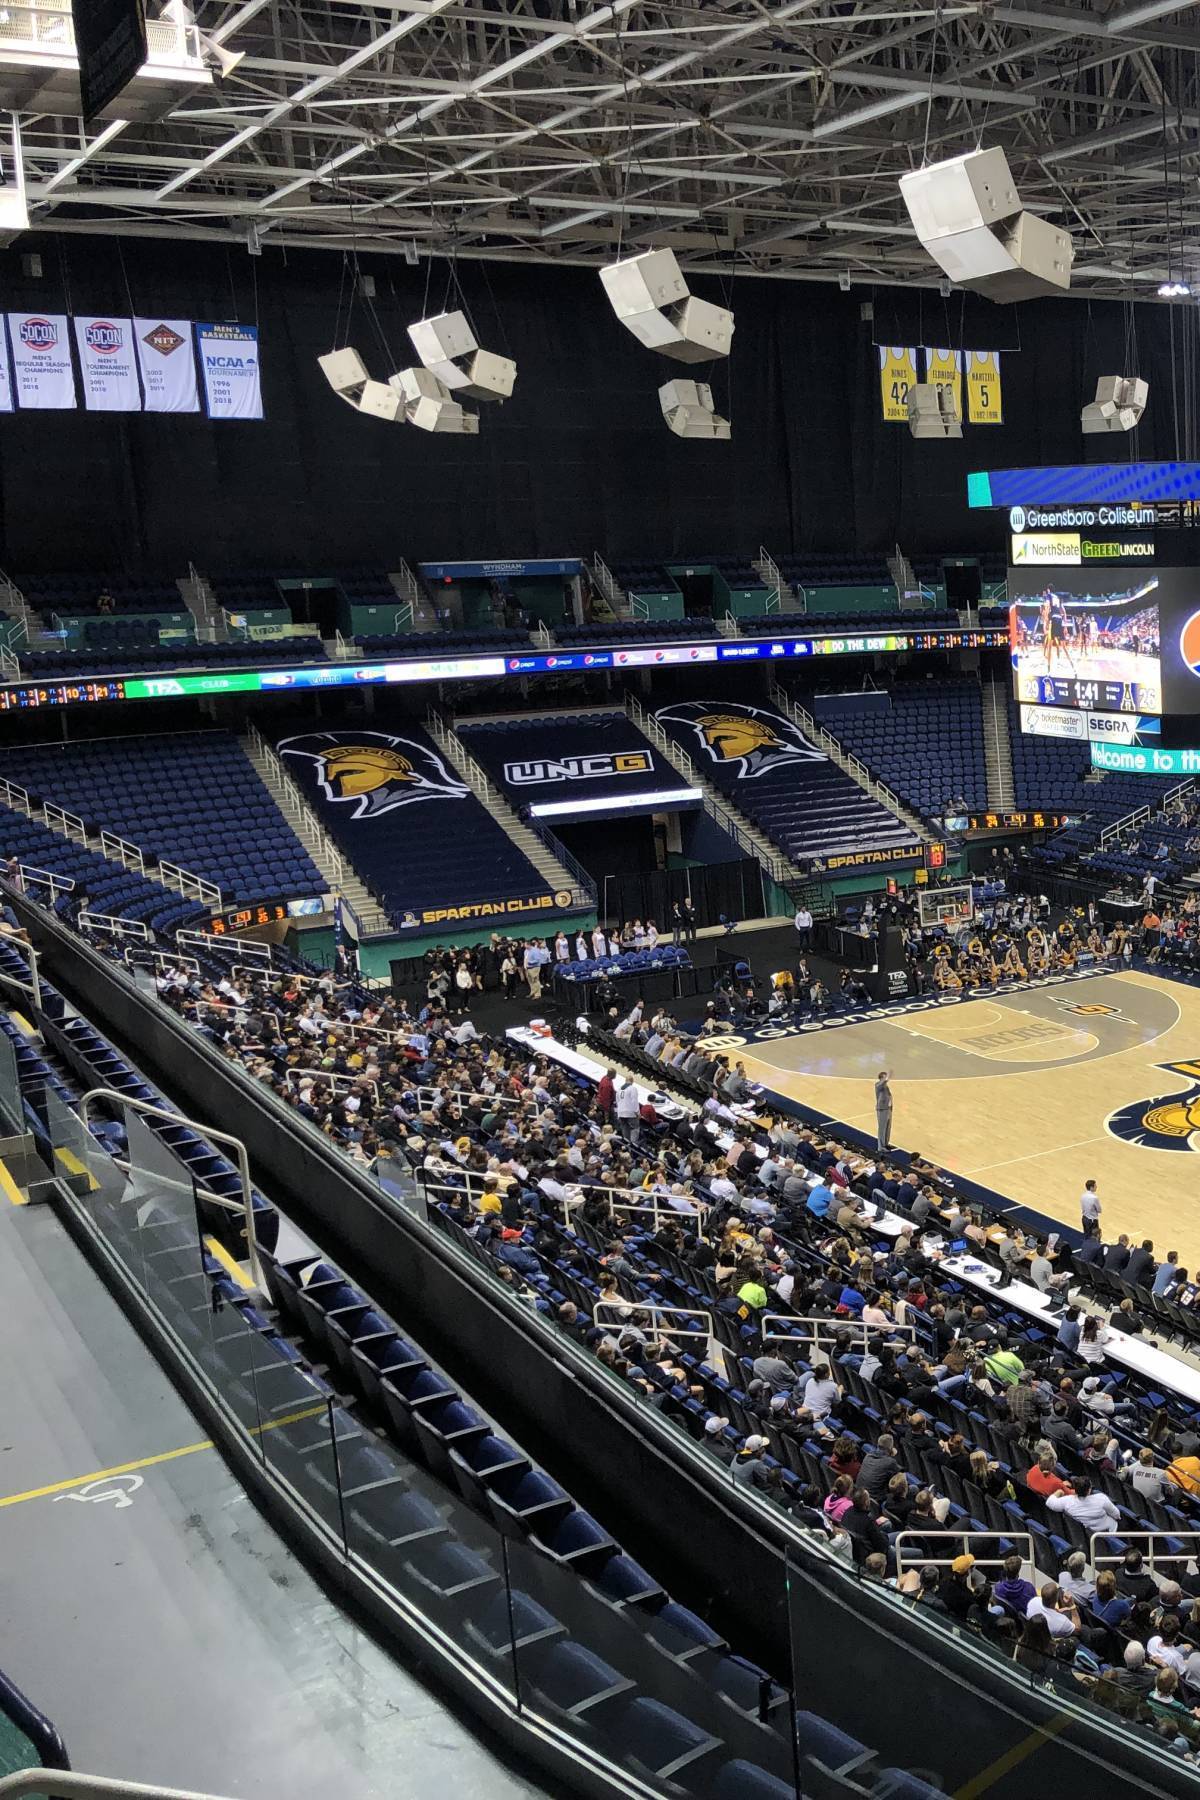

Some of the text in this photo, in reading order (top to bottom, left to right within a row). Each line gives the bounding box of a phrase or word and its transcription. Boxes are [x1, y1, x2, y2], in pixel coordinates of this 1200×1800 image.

[20, 323, 57, 344] SOCON
[85, 328, 123, 346] SOCON
[154, 336, 176, 346] NIT
[202, 331, 254, 340] BASKETBALL
[206, 357, 244, 368] NCAA
[891, 382, 908, 406] 42
[981, 385, 988, 408] 5
[1028, 506, 1154, 527] Greensboro Coliseum
[1032, 541, 1080, 556] NorthState
[482, 564, 523, 572] WYNDHAM
[832, 638, 886, 650] DO THE DEW
[67, 689, 78, 698] 10
[97, 688, 108, 698] 21
[144, 680, 185, 696] TFA
[1024, 680, 1039, 698] 29
[1074, 682, 1098, 700] 1:41
[1140, 688, 1156, 709] 26
[1042, 714, 1078, 726] ticketmaster
[1090, 718, 1130, 732] SEGRA
[1091, 742, 1146, 770] Welcome
[1153, 751, 1174, 770] to
[506, 751, 653, 784] UNCG
[828, 850, 892, 868] SPARTAN
[422, 896, 554, 924] SPARTAN CLUB
[888, 970, 908, 980] TFA
[754, 966, 1114, 1040] Greensboro Coliseum
